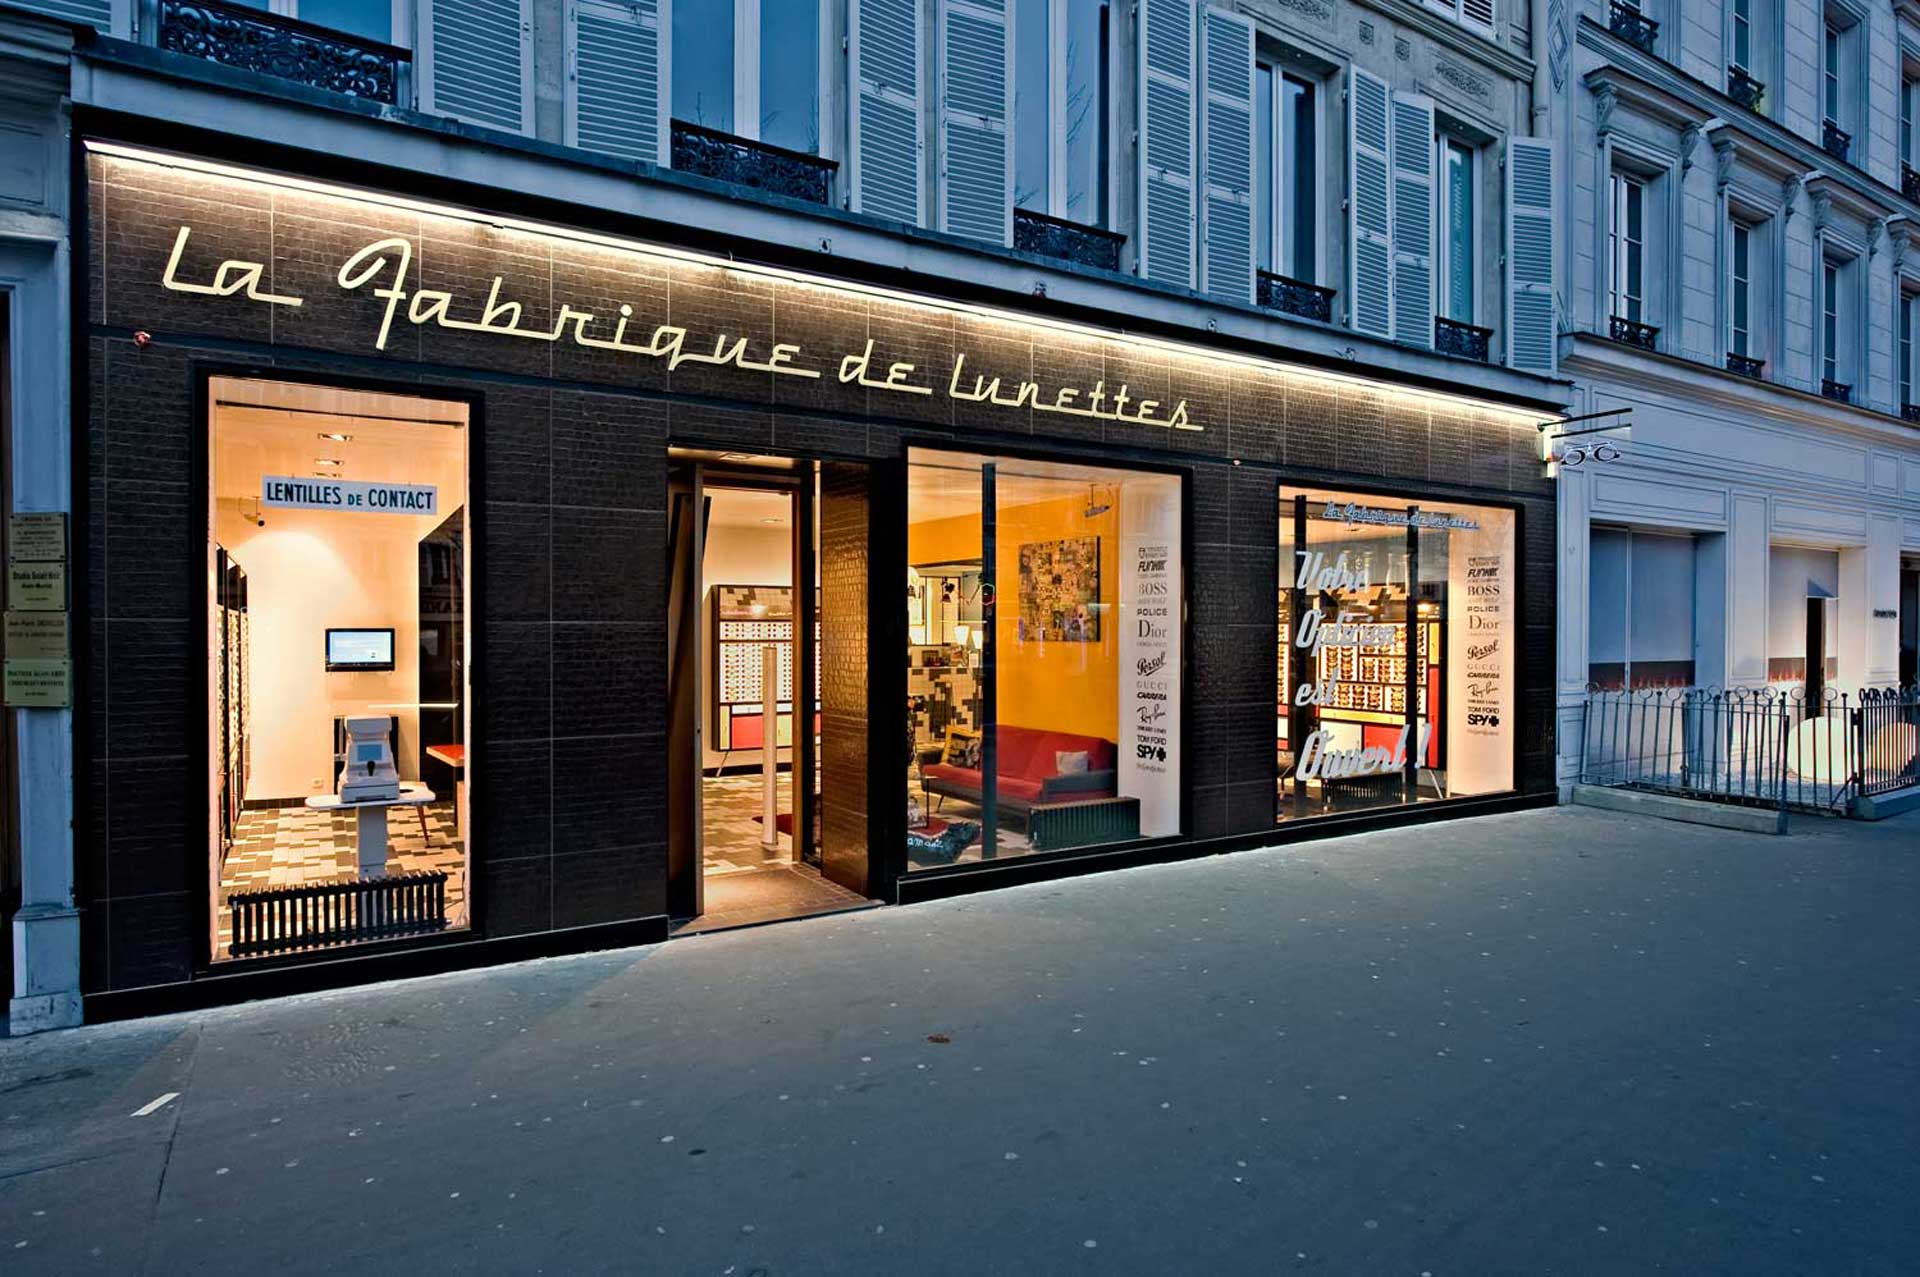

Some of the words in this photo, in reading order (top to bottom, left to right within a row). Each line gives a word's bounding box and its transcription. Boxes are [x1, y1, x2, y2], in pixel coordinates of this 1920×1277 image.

[163, 227, 303, 306] La
[338, 238, 820, 378] Fabrique
[838, 339, 932, 394] de
[266, 482, 342, 505] LENTILLES
[368, 489, 433, 510] CONTACT
[1296, 551, 1370, 592] Votre
[1139, 583, 1168, 596] BOSS
[1467, 585, 1500, 597] BOSS
[1137, 608, 1168, 617] POLICE
[1138, 620, 1168, 638] Dior
[1468, 615, 1500, 630] Dior
[1295, 608, 1396, 657] Opticien
[1467, 640, 1500, 660] Persol
[1137, 651, 1168, 677] Persol
[1137, 681, 1168, 690] GUCCI
[1295, 667, 1339, 707] est
[1467, 713, 1488, 726] SPY
[1137, 744, 1156, 760] SPY
[1295, 723, 1411, 782] Ouvert
